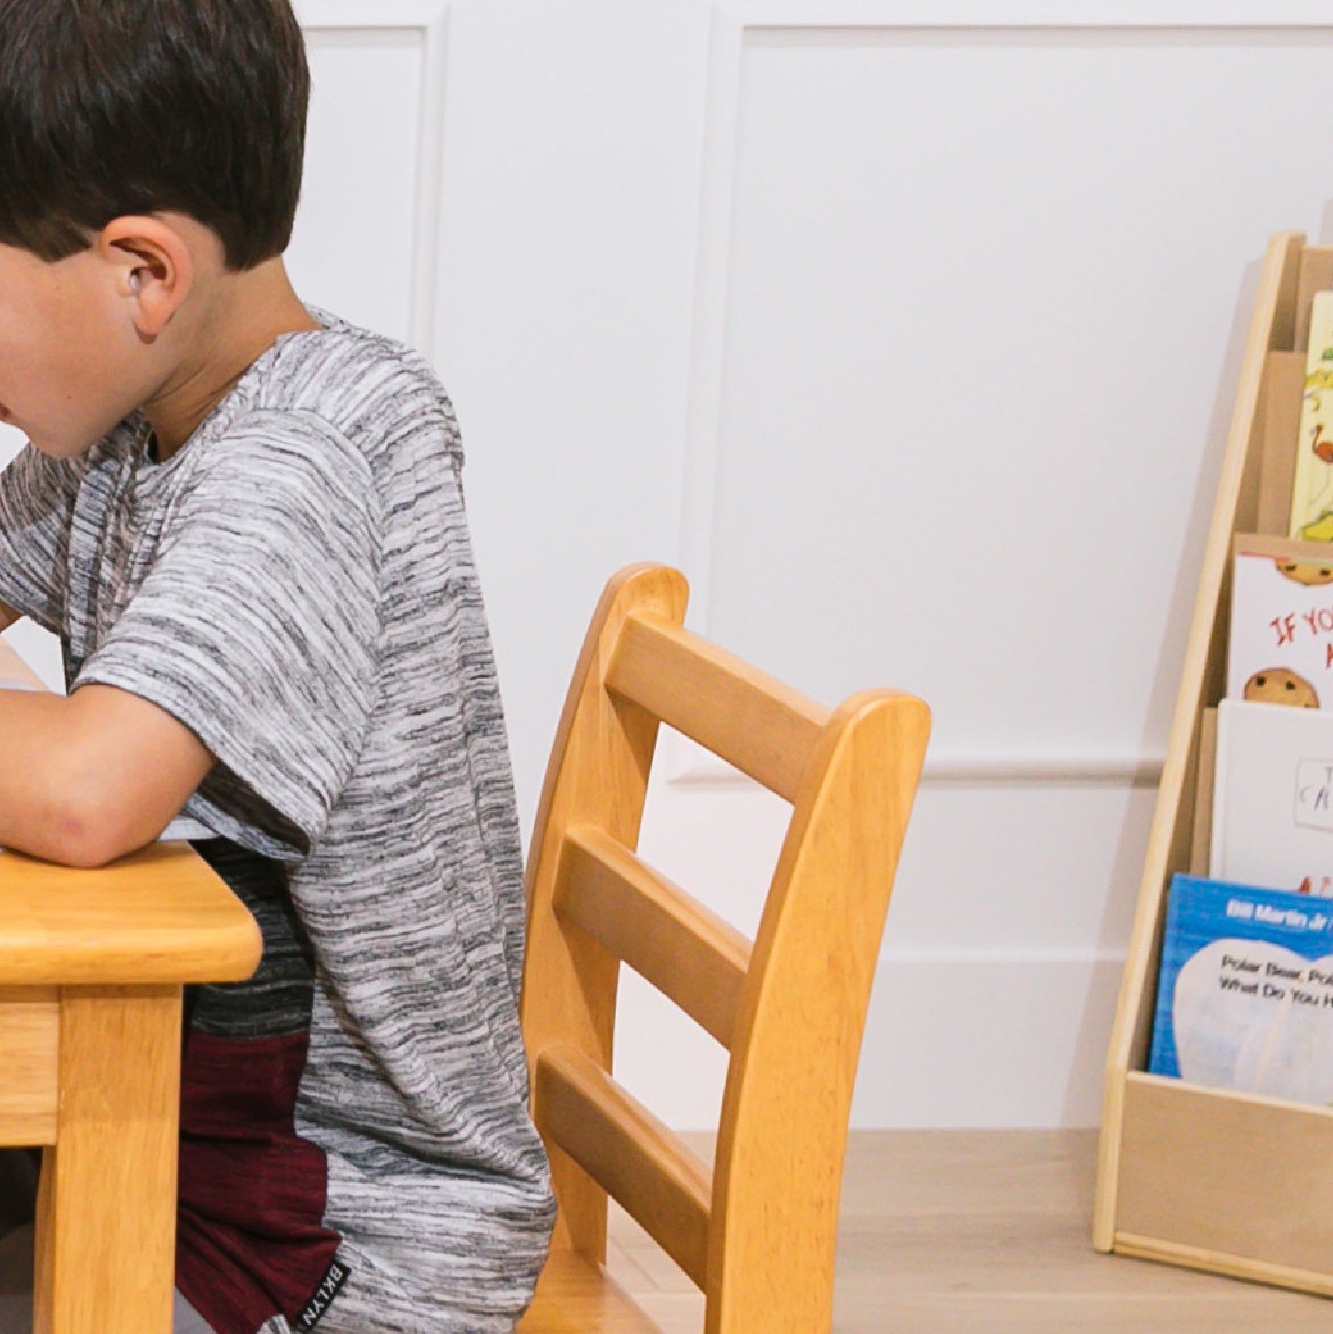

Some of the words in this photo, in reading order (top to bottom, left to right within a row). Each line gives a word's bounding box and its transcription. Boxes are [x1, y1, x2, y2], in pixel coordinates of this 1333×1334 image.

[1219, 976, 1259, 994] What
[1262, 984, 1285, 1000] Do
[302, 1264, 344, 1327] BKLYN
